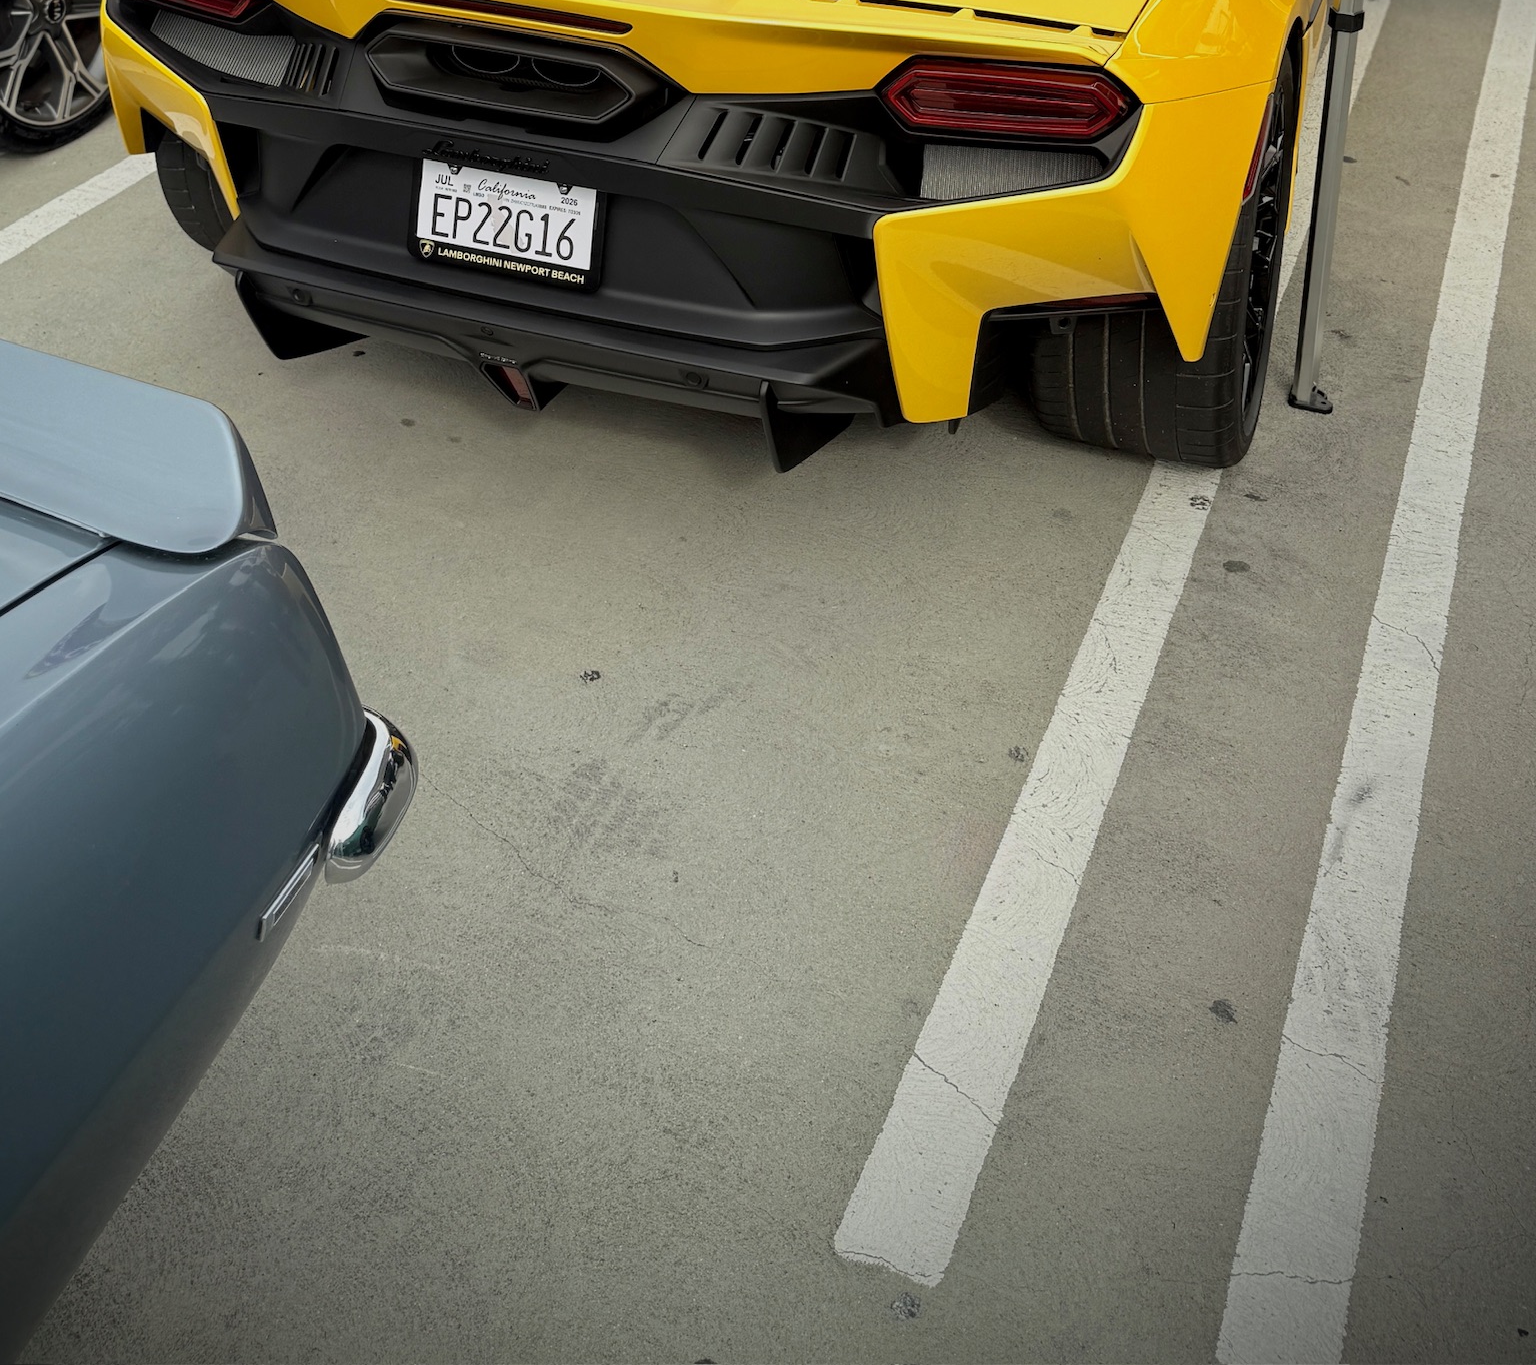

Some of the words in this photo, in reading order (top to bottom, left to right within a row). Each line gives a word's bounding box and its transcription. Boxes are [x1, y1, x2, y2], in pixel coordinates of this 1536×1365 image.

[435, 174, 454, 187] JUL
[477, 178, 537, 201] California
[560, 196, 579, 207] 2026
[431, 193, 577, 261] EP22G16
[437, 246, 503, 268] LAMBORGHINI
[503, 259, 551, 277] NEWPORT
[551, 269, 585, 285] BEACH
